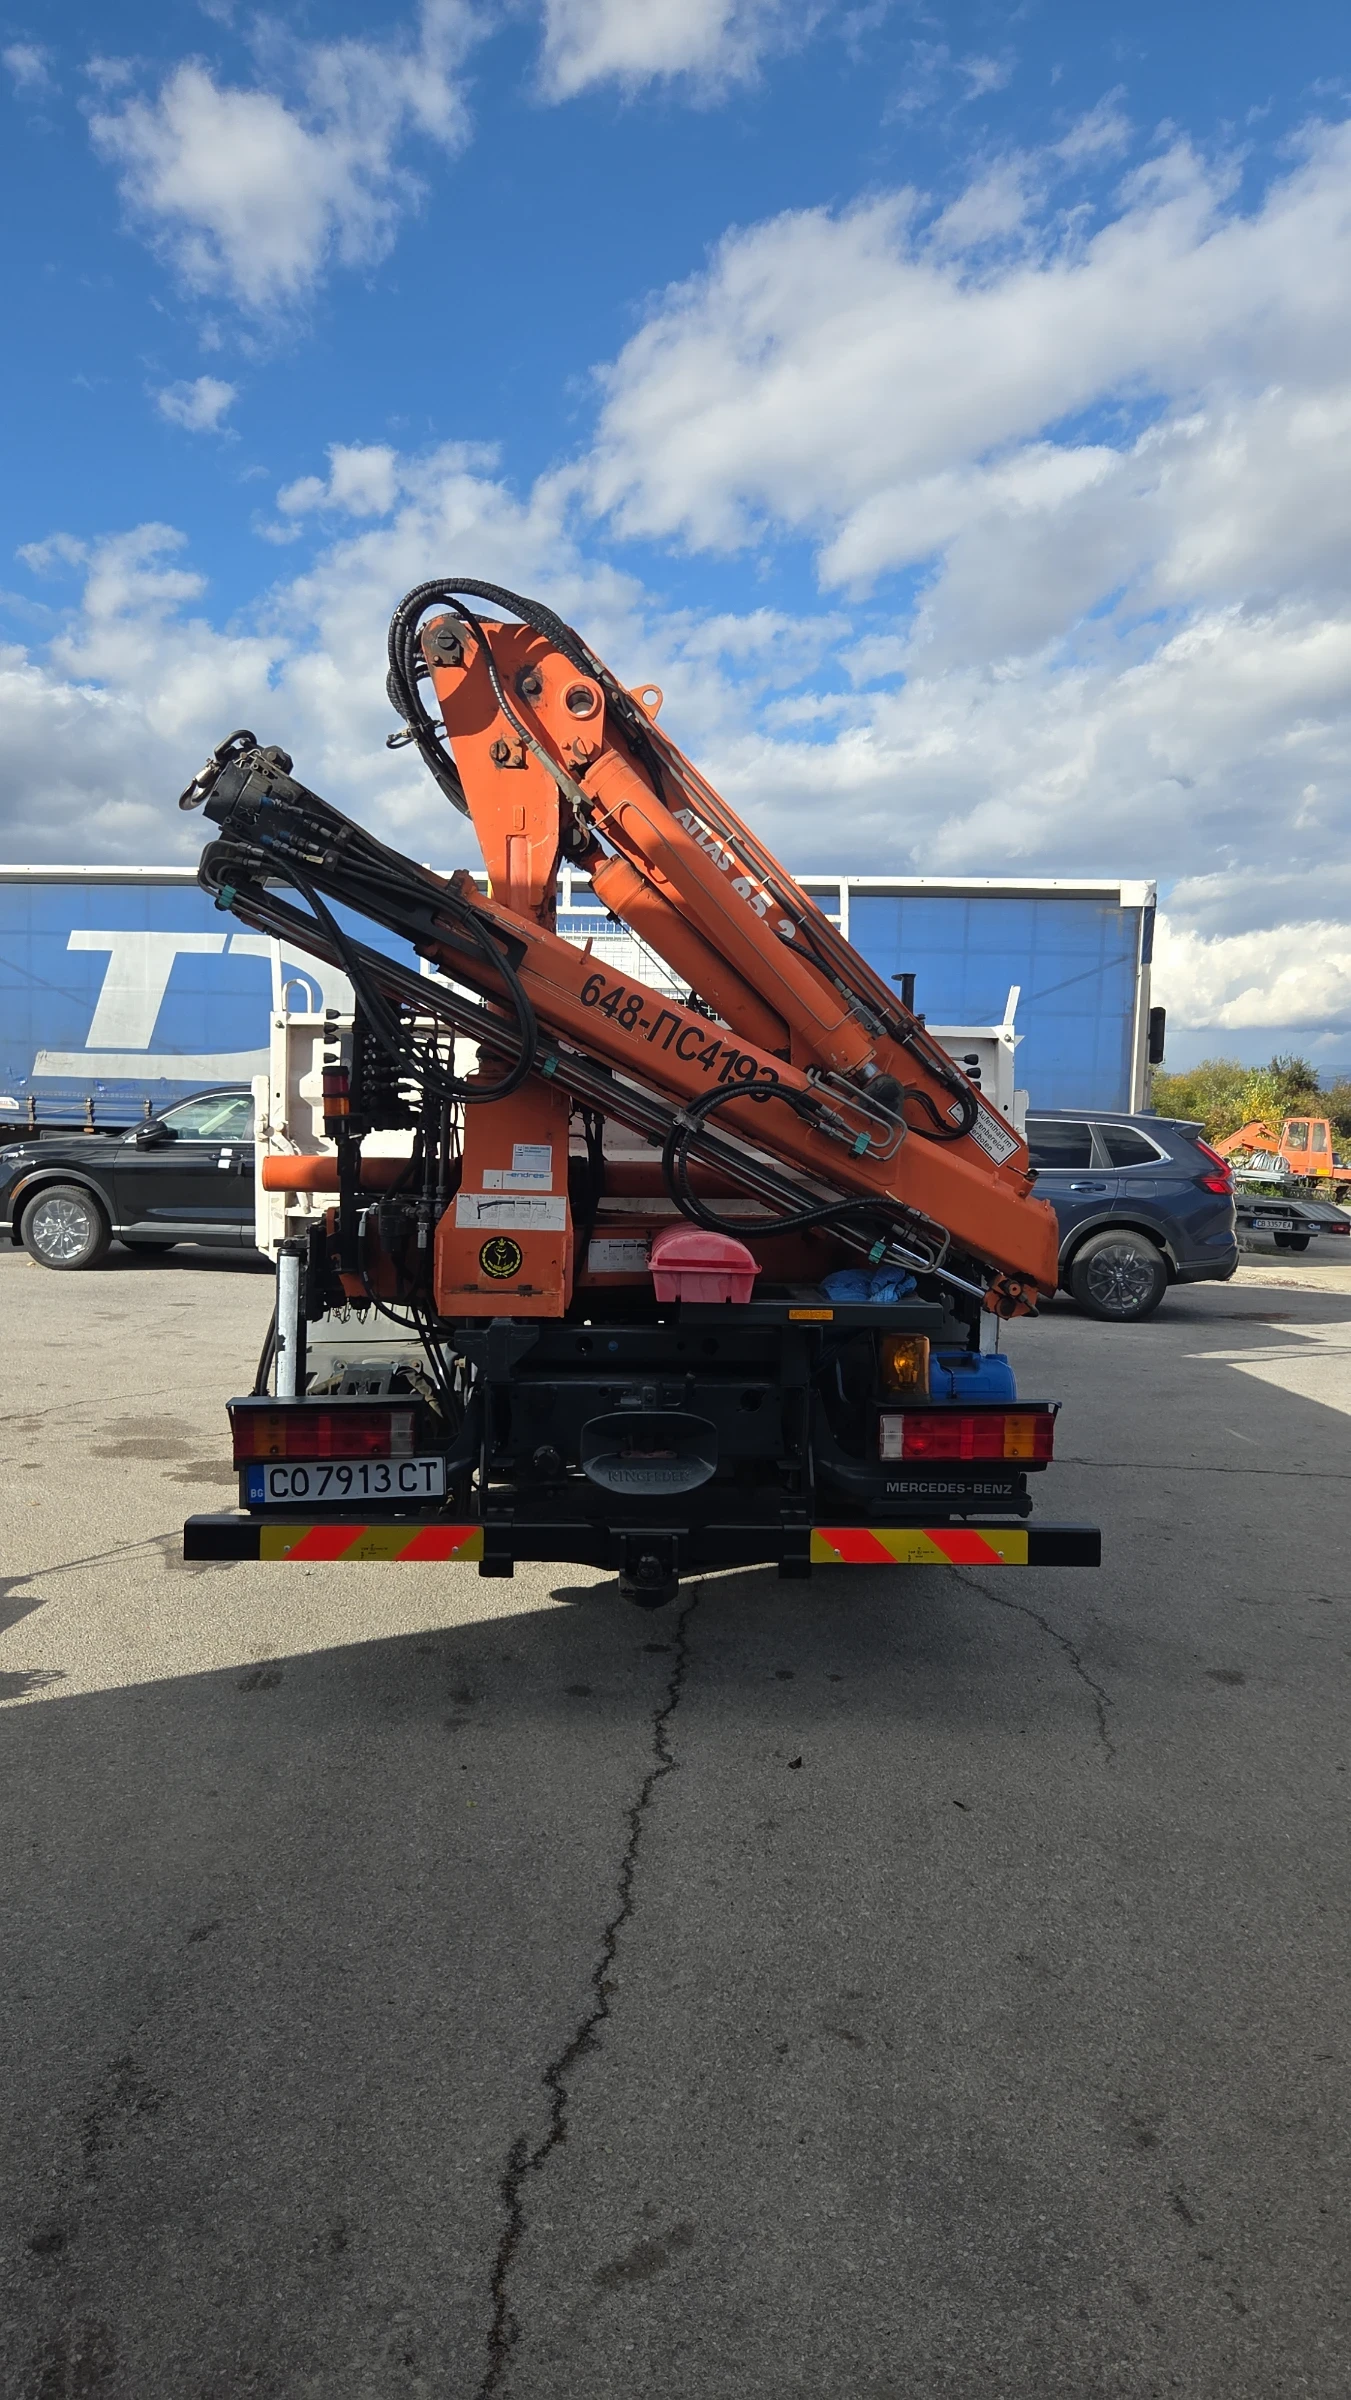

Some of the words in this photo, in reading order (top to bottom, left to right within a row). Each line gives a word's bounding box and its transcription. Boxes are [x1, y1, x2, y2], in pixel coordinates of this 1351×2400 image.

[672, 808, 736, 871] ATLAS
[970, 1127, 993, 1152] erboten
[974, 1119, 1005, 1153] renbereich
[978, 1110, 1006, 1140] Aufenthalt
[1003, 1137, 1012, 1148] im
[250, 1488, 264, 1498] BG
[886, 1482, 1013, 1495] MERCEDES-BENZ
